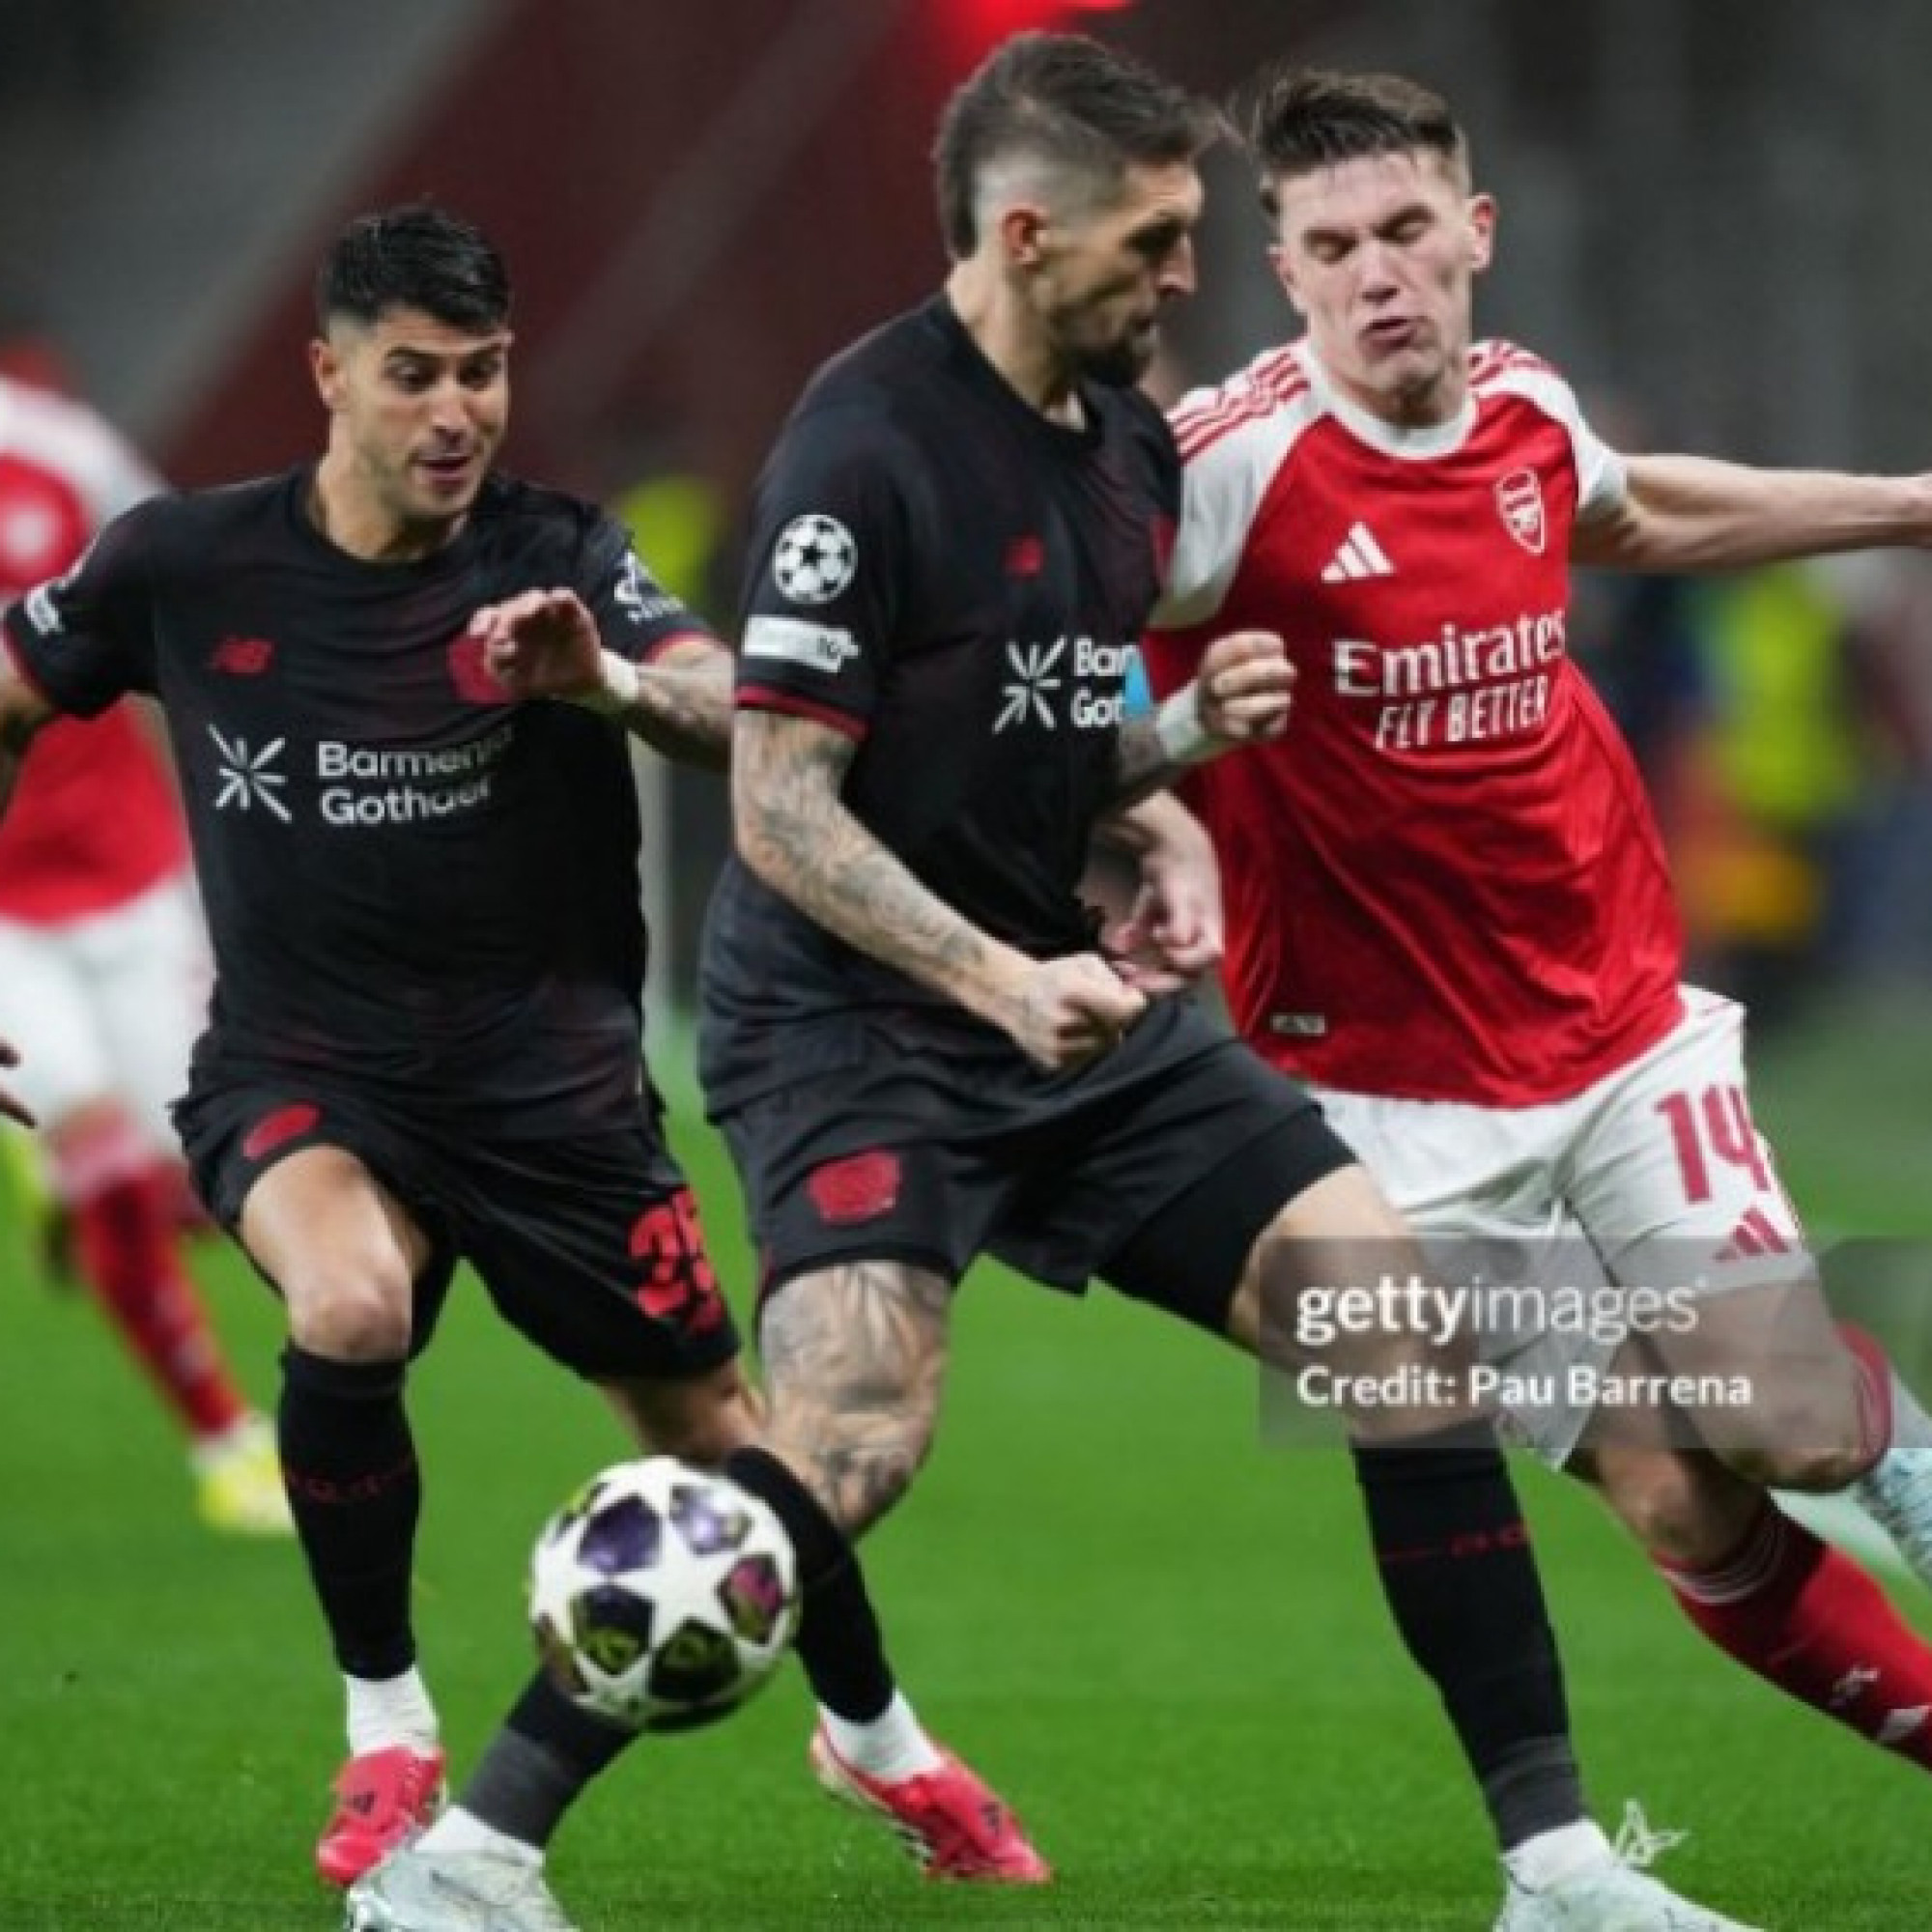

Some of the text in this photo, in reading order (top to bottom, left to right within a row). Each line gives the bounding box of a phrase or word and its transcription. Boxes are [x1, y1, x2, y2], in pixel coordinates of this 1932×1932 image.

[1333, 608, 1566, 696] Emirates
[1374, 674, 1548, 750] FLY BETTER
[1654, 1084, 1770, 1204] 14
